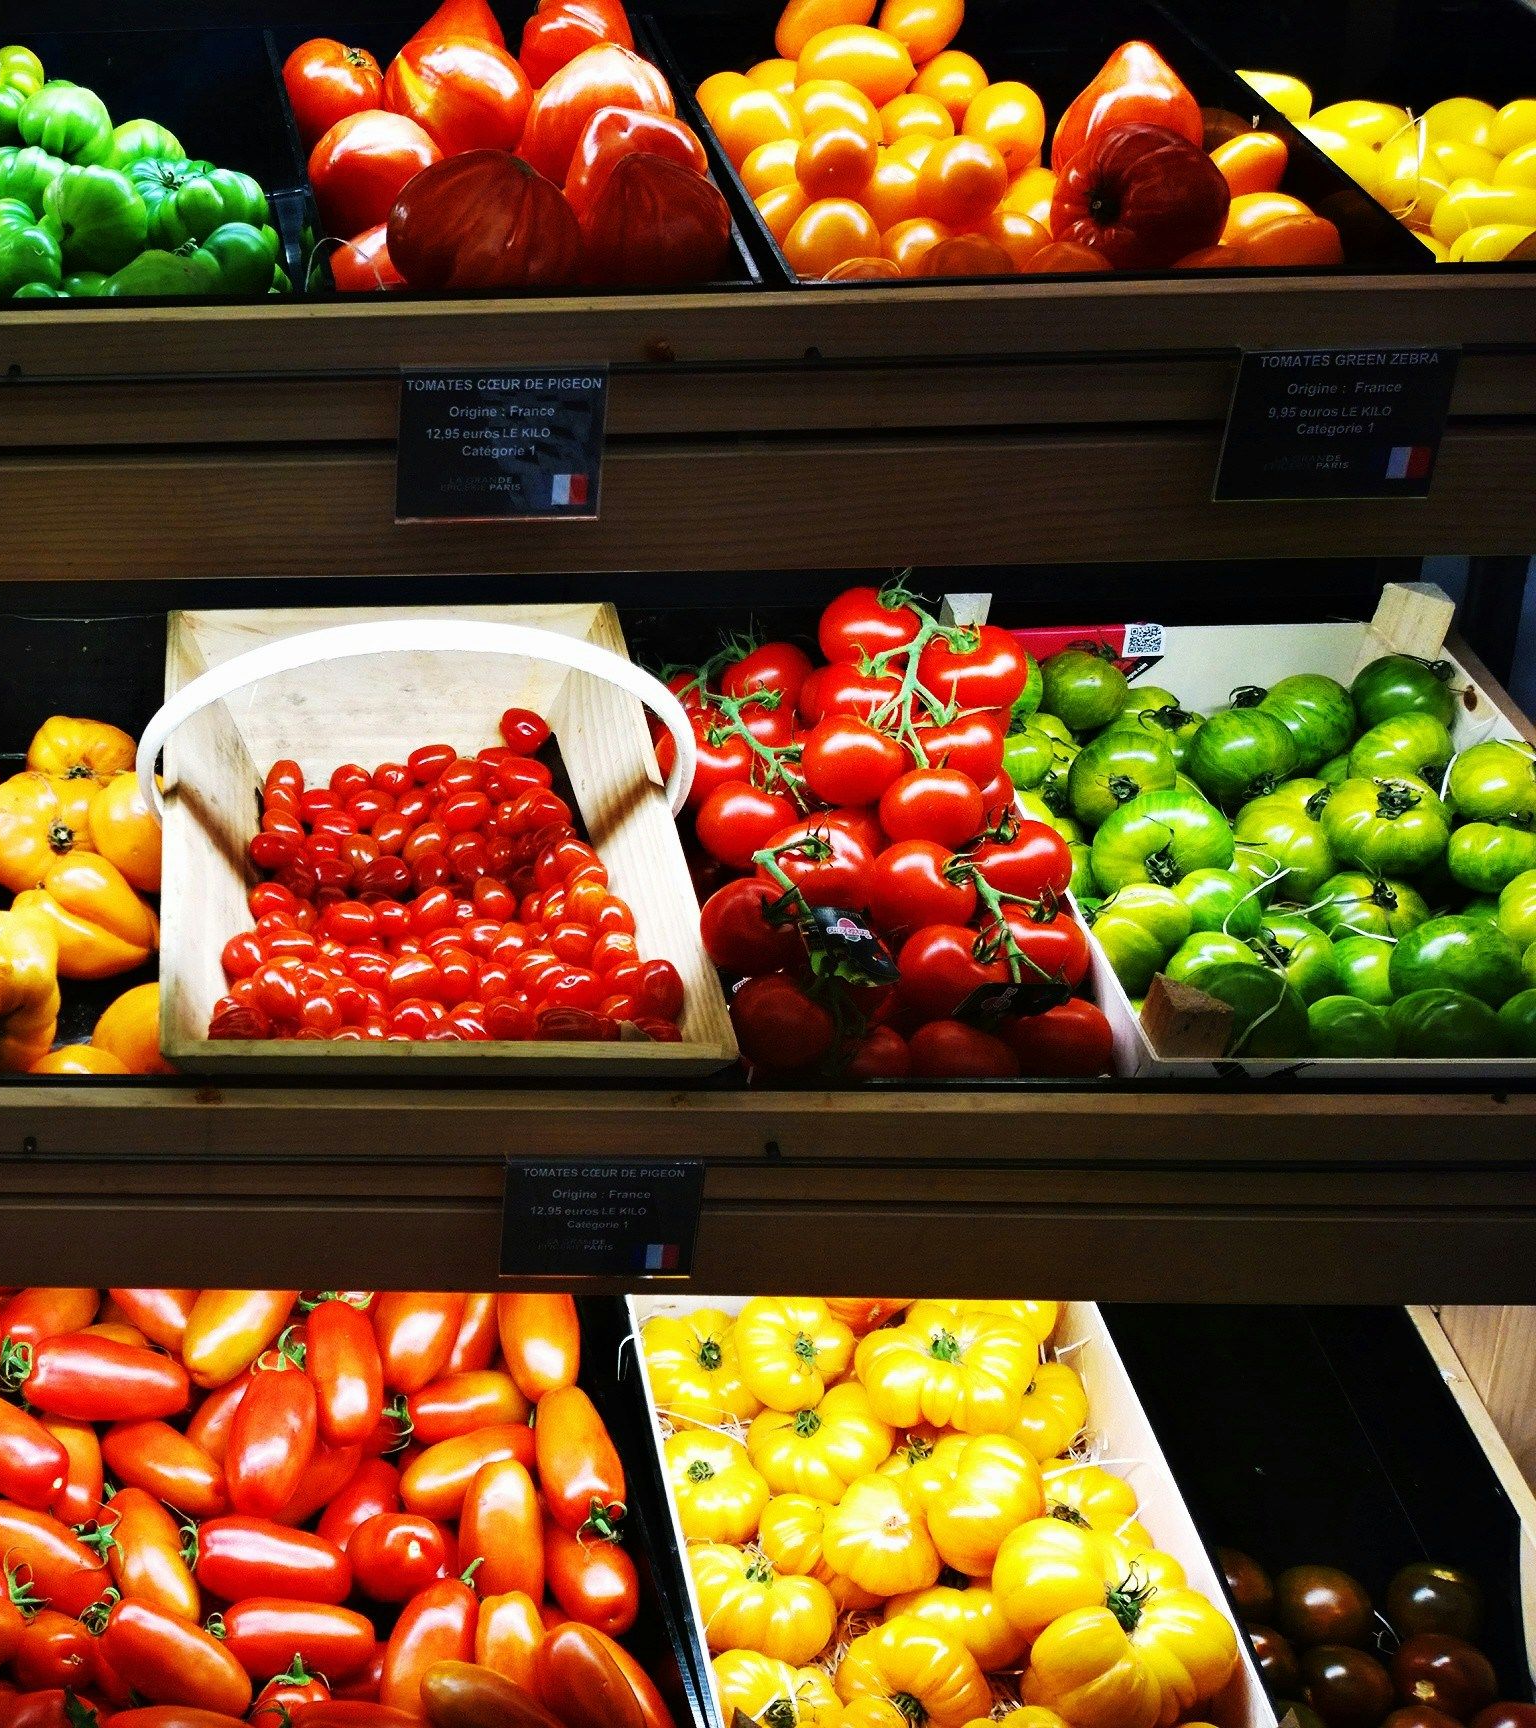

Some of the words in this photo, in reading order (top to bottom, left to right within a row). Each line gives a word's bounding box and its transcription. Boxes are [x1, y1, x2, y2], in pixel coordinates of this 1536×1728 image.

[1260, 355, 1330, 368] TOMATES
[1335, 354, 1386, 366] GREEN
[1390, 352, 1440, 365] ZEBRA
[406, 380, 472, 391] TOMATES
[477, 379, 521, 390] CŒUR
[525, 379, 543, 390] DE
[548, 378, 602, 390] PIGEON
[1287, 383, 1337, 397] Origine
[1355, 382, 1402, 393] France
[449, 406, 498, 420] Origine
[509, 406, 555, 417] France
[1268, 407, 1296, 419] 9,95
[1299, 408, 1338, 418] euros
[1342, 407, 1357, 417] LE
[1362, 406, 1392, 417] KILO
[427, 428, 460, 440] 12,95
[462, 430, 500, 439] euros
[503, 428, 517, 438] LE
[522, 428, 551, 438] KILO
[523, 1168, 578, 1178] TOMATES
[581, 1168, 618, 1178] CŒUR
[621, 1169, 637, 1178] DE
[640, 1169, 685, 1178] PIGEON
[552, 1190, 597, 1200] Origine
[609, 1190, 651, 1199] France
[564, 1208, 599, 1216] euros
[602, 1207, 615, 1216] LE
[619, 1207, 647, 1216] KILO
